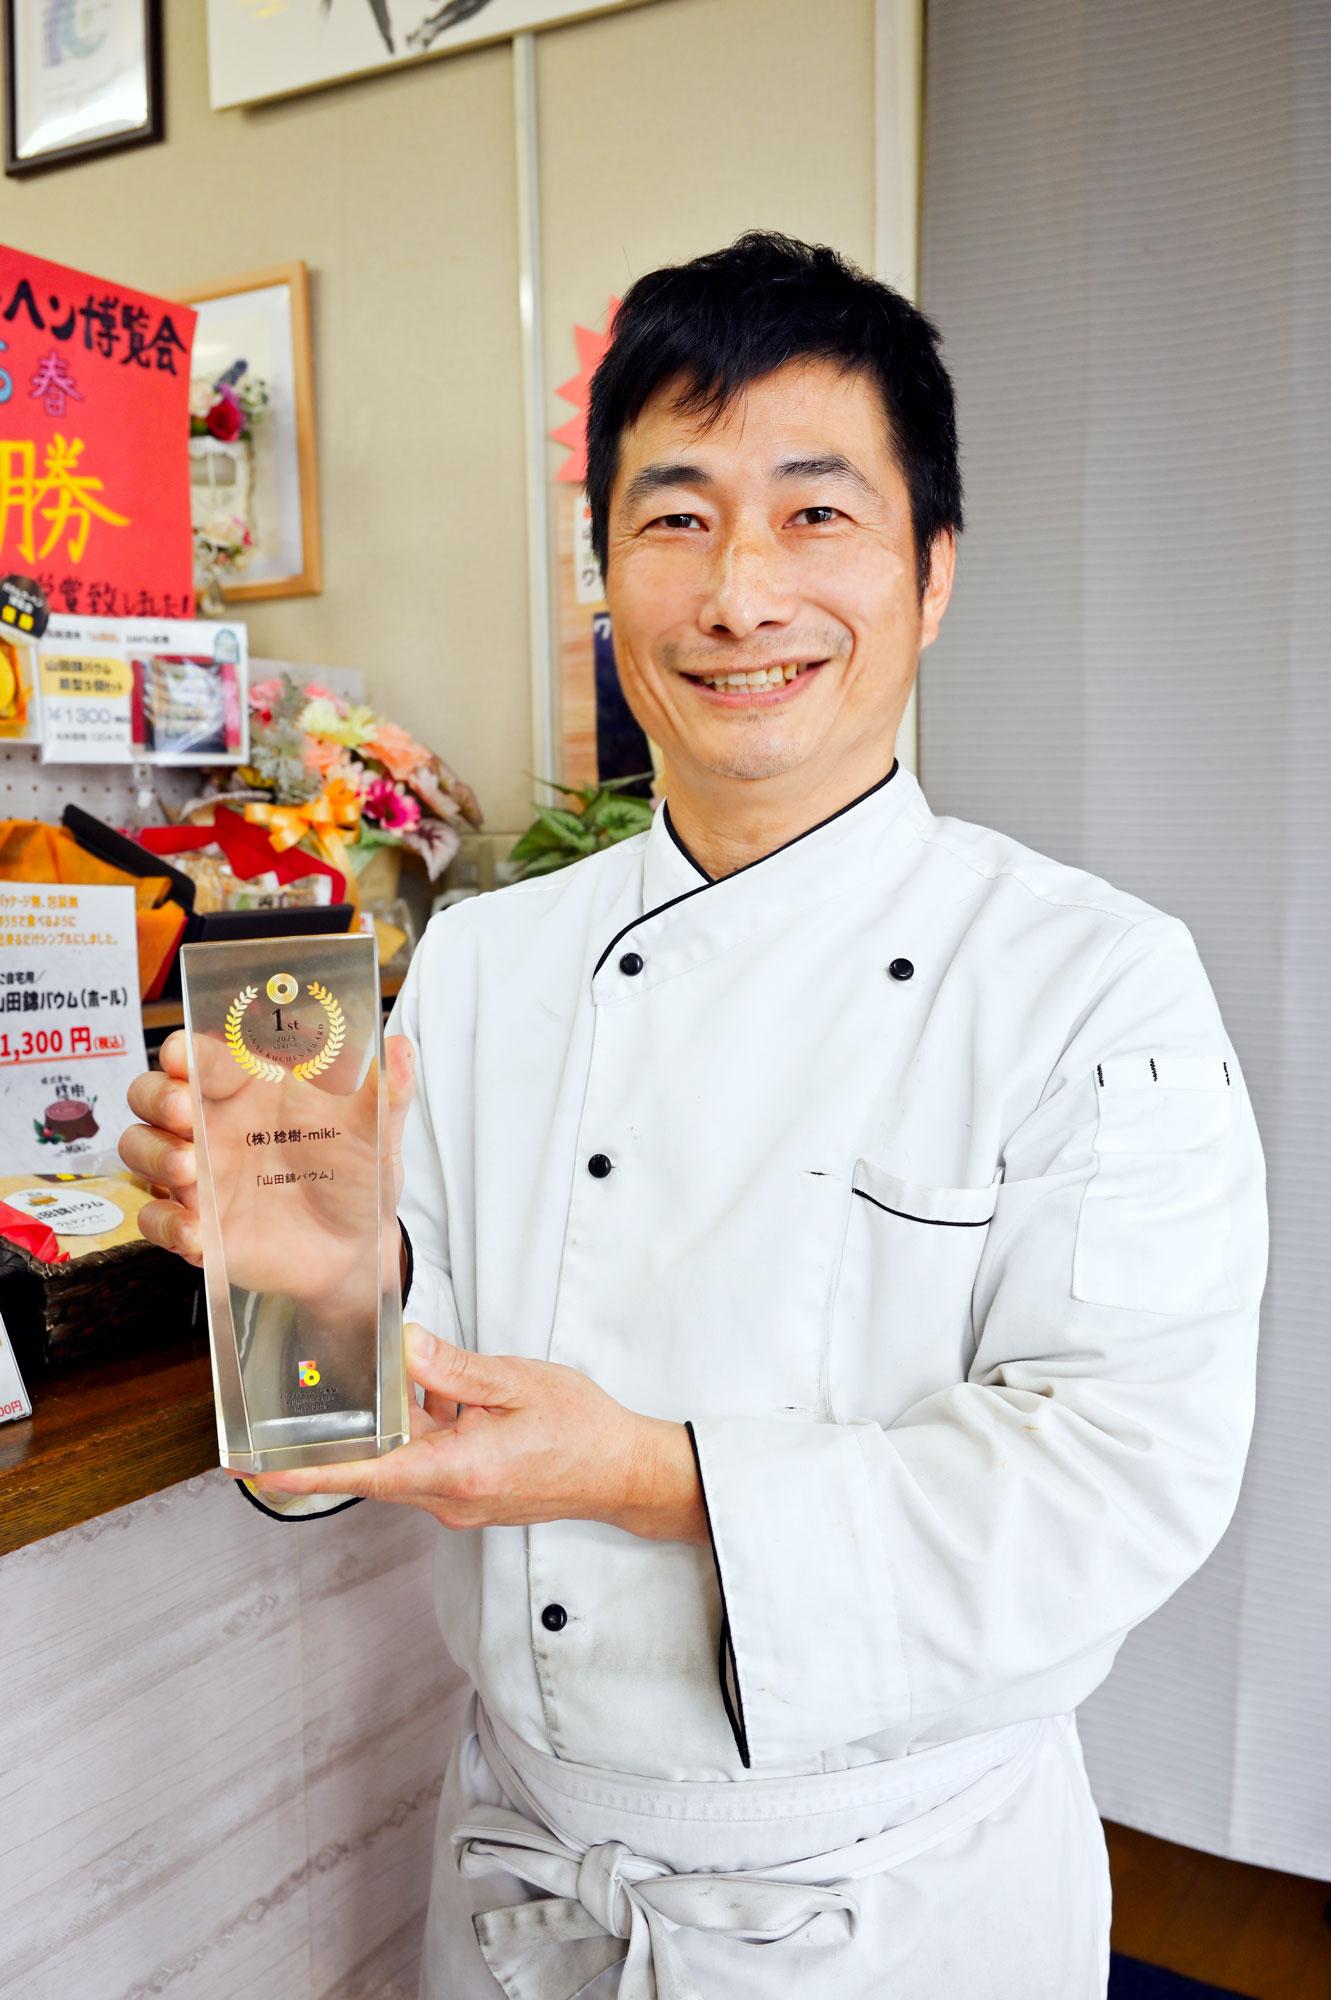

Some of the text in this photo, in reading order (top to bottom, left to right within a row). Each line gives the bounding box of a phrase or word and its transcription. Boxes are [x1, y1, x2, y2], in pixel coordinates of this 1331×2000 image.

[4, 280, 187, 376] ヘン博覧会
[31, 348, 84, 418] 春
[0, 432, 131, 564] 勝
[272, 1008, 300, 1032] 1st
[256, 1168, 335, 1187] 「山田錦バウム」
